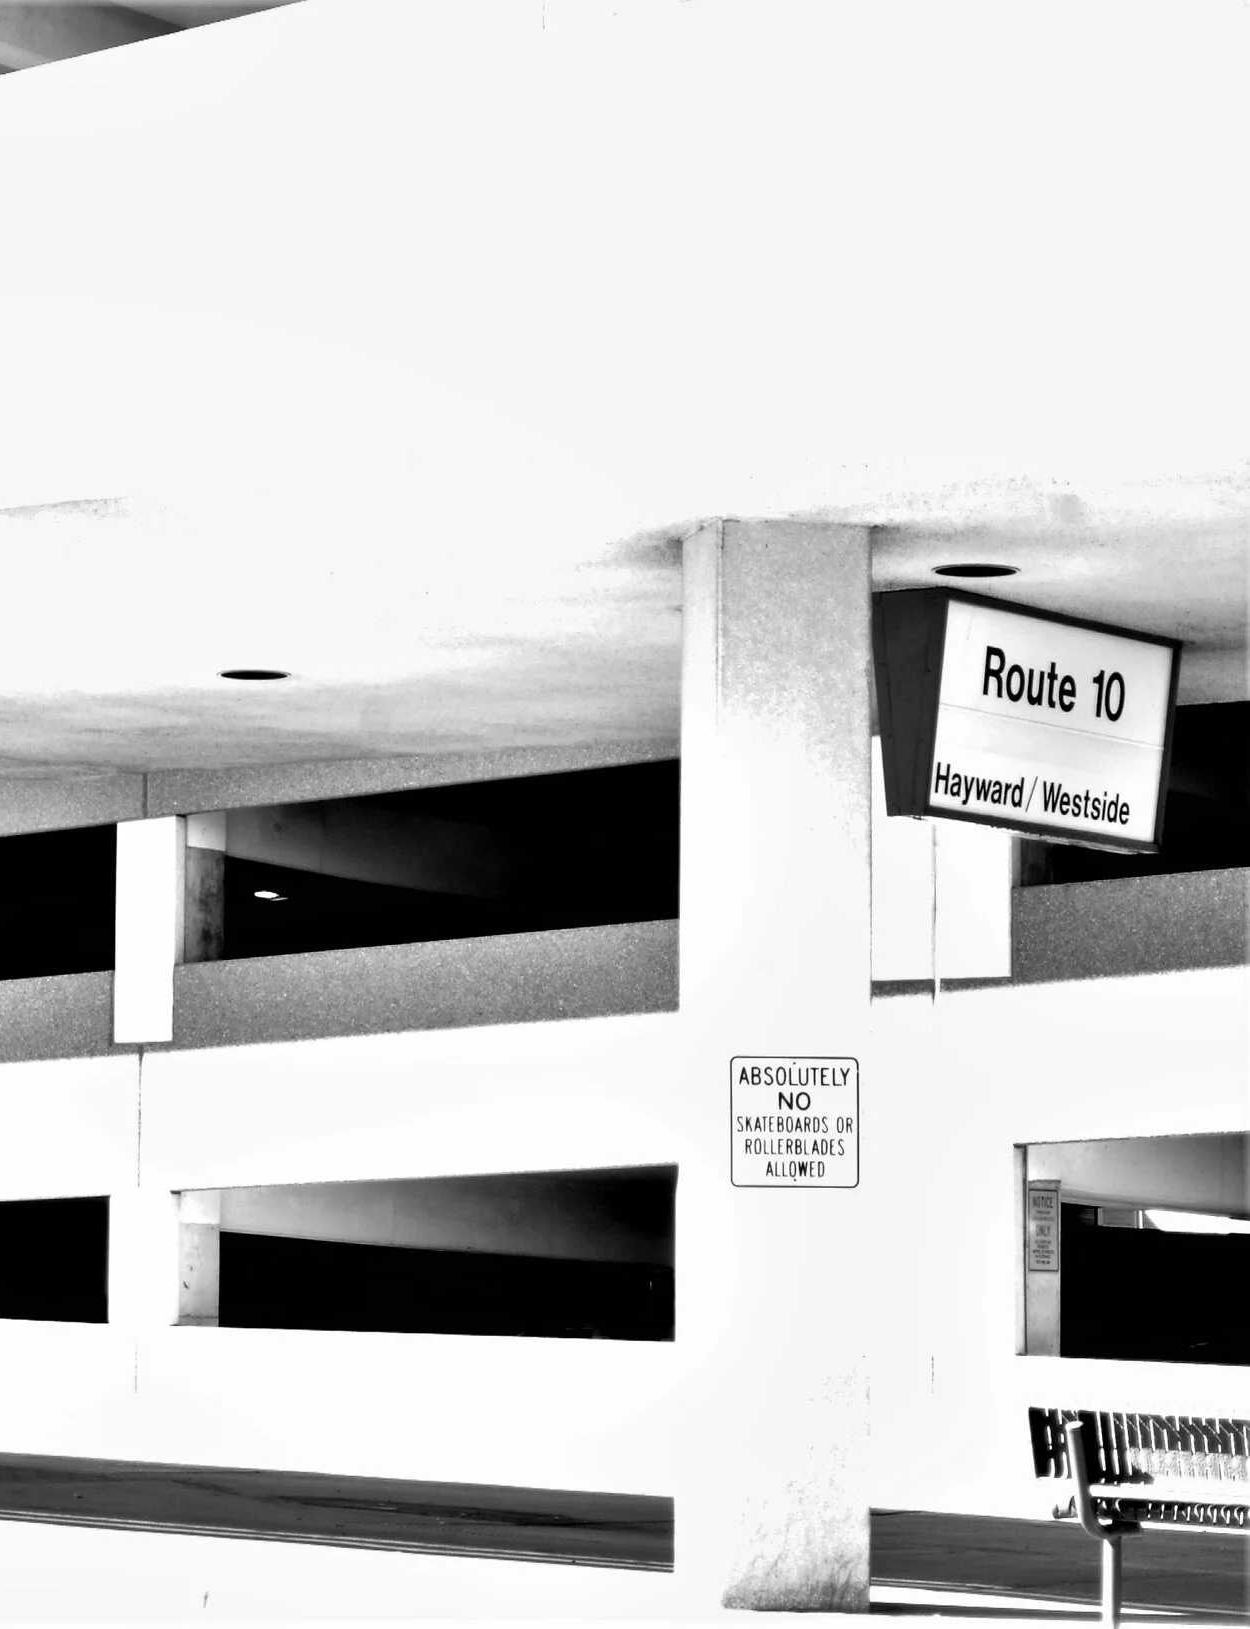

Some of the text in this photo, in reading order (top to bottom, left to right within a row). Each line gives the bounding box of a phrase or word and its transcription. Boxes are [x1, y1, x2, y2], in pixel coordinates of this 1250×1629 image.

[983, 646, 1125, 722] Route 10
[739, 1066, 851, 1086] ABSOLUTELY
[778, 1091, 811, 1111] NO
[737, 1116, 853, 1133] SKATEBOARDS OR
[745, 1138, 845, 1156] ROLLERBLADES
[766, 1161, 825, 1177] ALLOWED
